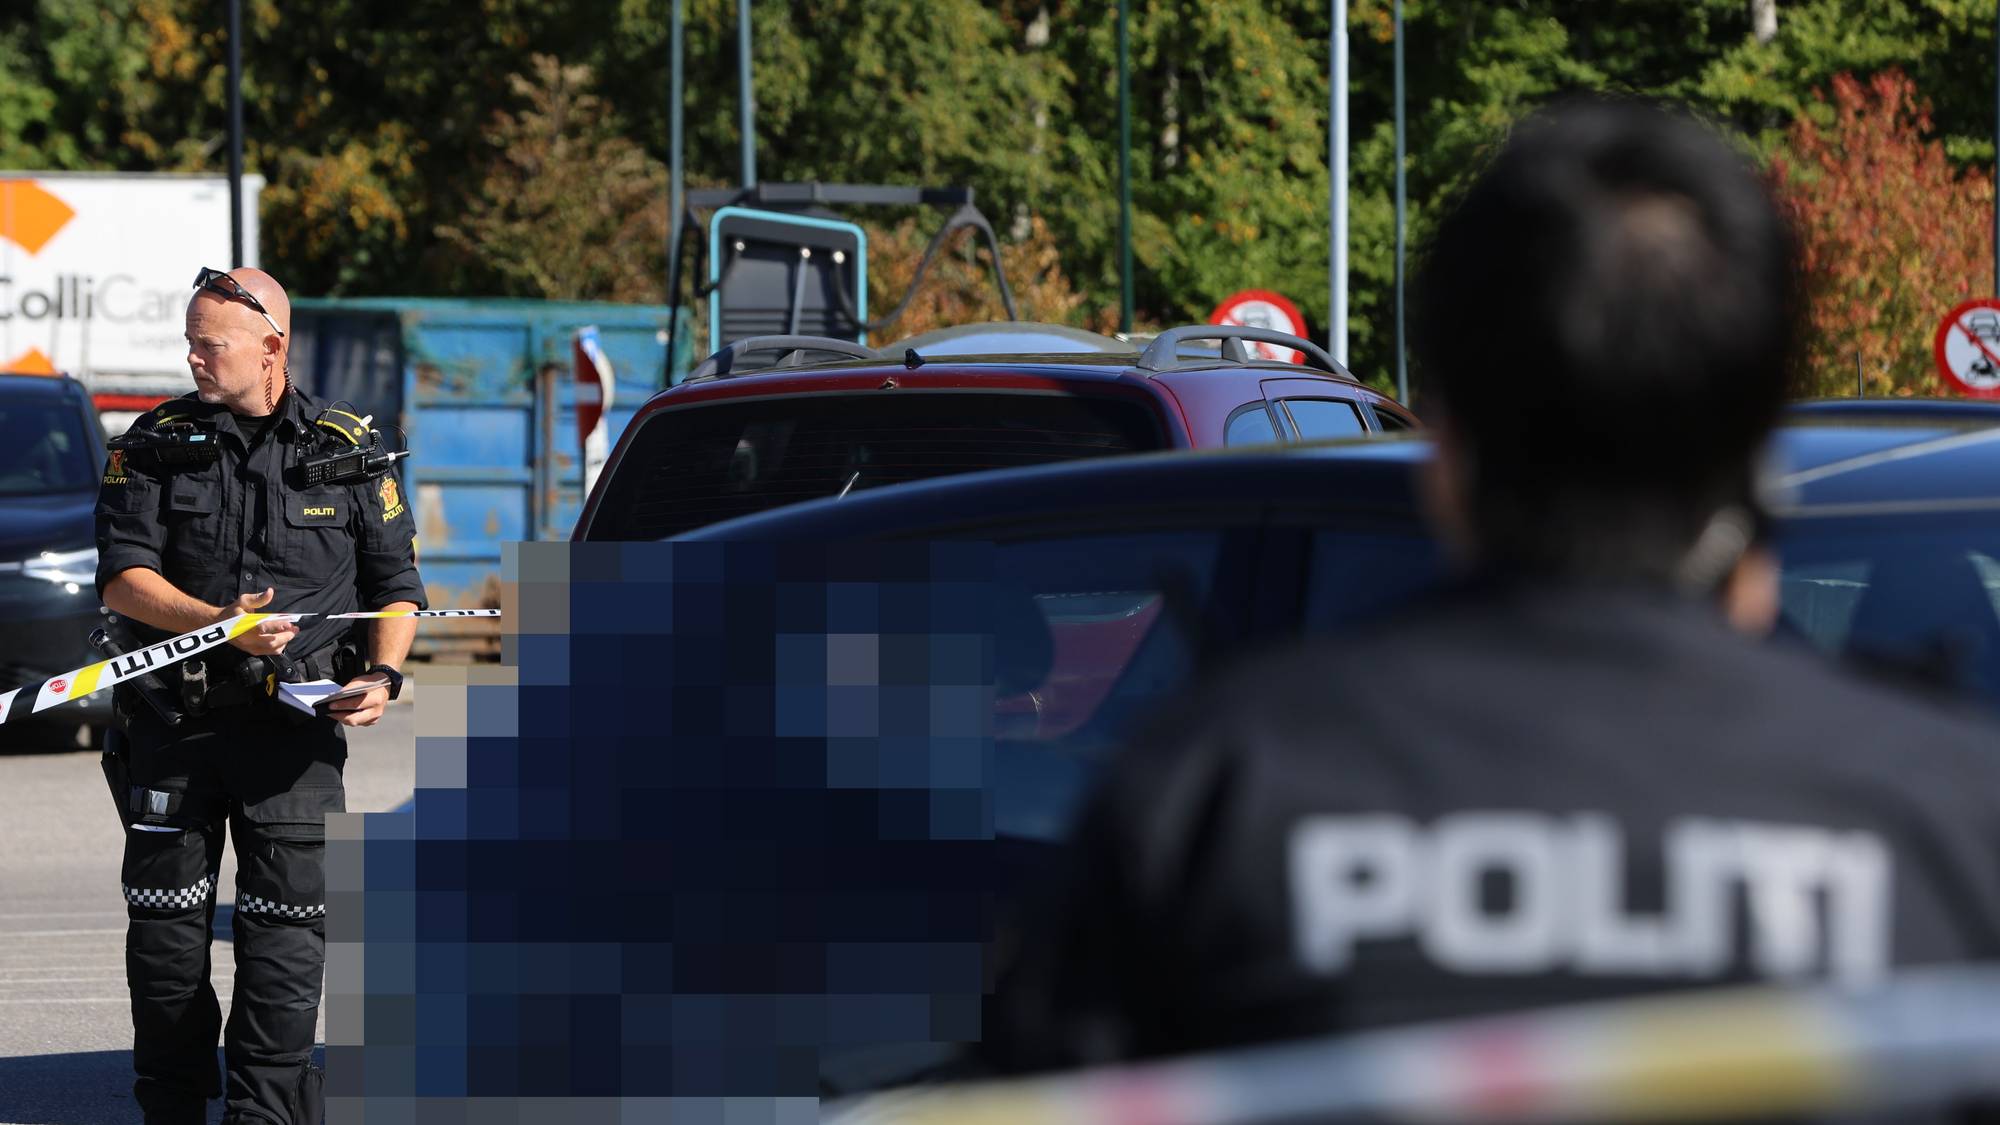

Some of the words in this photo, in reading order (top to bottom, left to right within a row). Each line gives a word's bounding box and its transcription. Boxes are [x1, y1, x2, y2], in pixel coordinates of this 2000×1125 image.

[103, 476, 128, 484] POLITI
[304, 508, 335, 516] POLITI
[382, 504, 404, 522] POLITI
[110, 626, 226, 679] POLITI
[1288, 813, 1892, 985] POLITI
